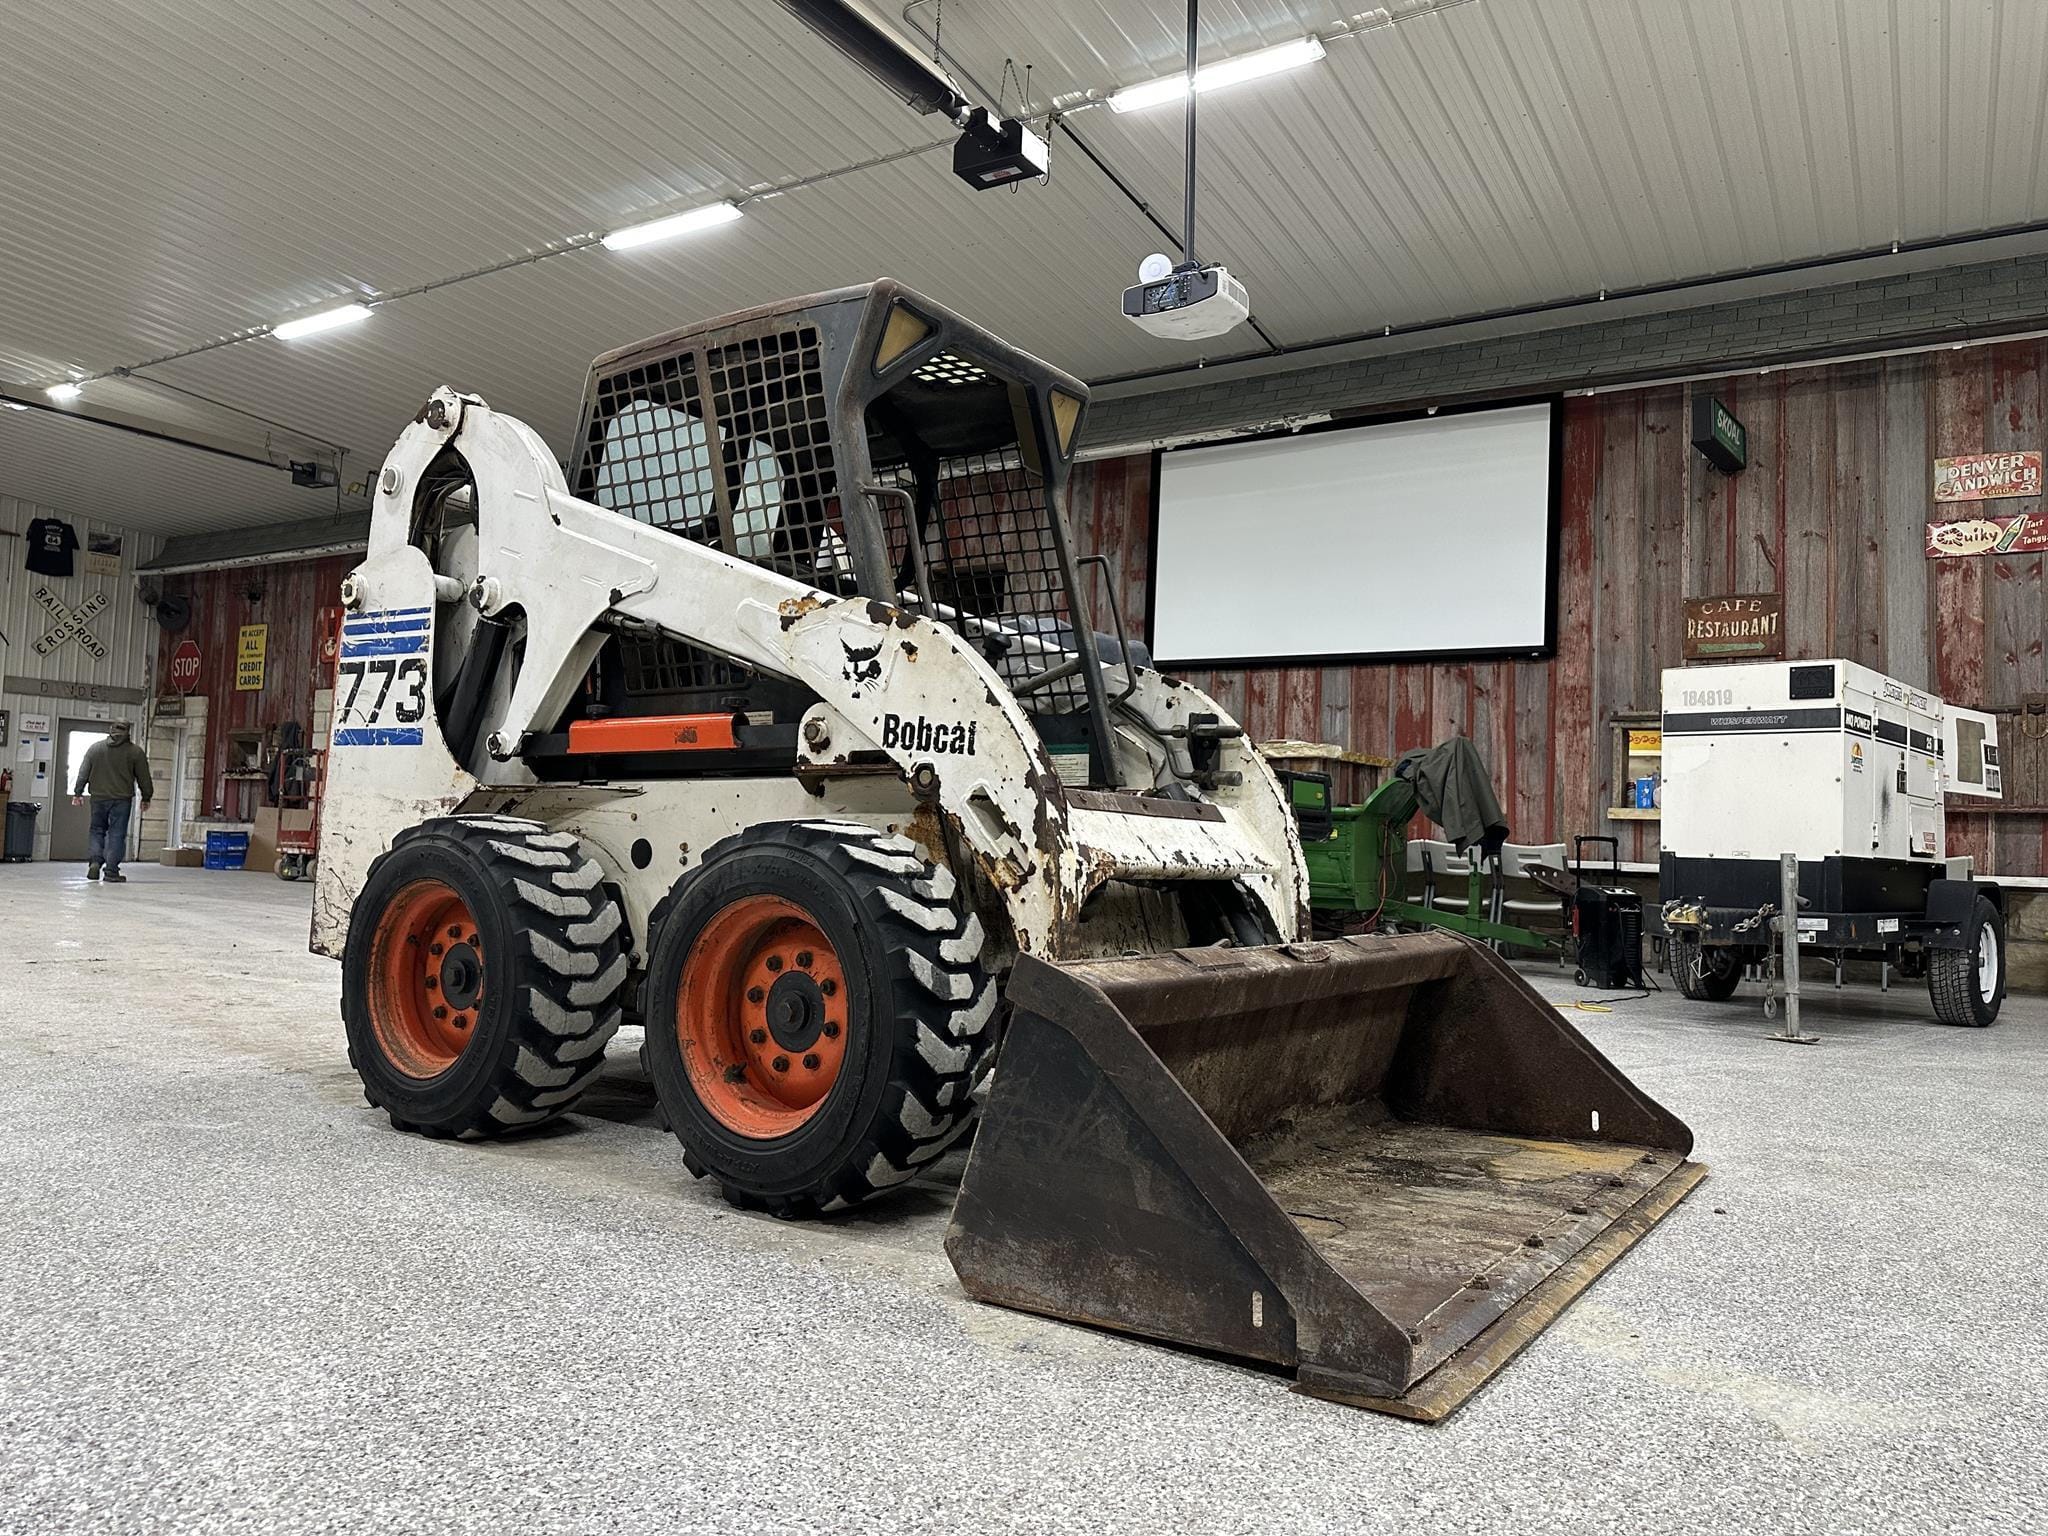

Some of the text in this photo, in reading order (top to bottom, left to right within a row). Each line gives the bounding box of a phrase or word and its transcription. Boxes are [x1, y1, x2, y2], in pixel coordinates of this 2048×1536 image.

[1717, 409, 1740, 445] SKOAL
[1947, 455, 2024, 479] DENVER
[1937, 467, 2036, 496] SANDWICH
[1936, 527, 1998, 547] Quiky
[1701, 600, 1762, 615] CAFE
[35, 587, 105, 658] RAIL ROAD
[36, 595, 106, 654] CROSSING
[1687, 612, 1778, 639] RESTAURANT
[248, 629, 264, 637] ACCEPT
[245, 640, 258, 650] ALL
[173, 656, 200, 677] STOP
[240, 661, 262, 672] CREDIT
[239, 674, 261, 686] CARDS
[338, 658, 428, 725] 773
[1682, 689, 1733, 707] 184819
[1710, 715, 1788, 726] WHISPERWATT
[1854, 715, 1870, 731] POWER
[882, 713, 977, 756] Bobcat
